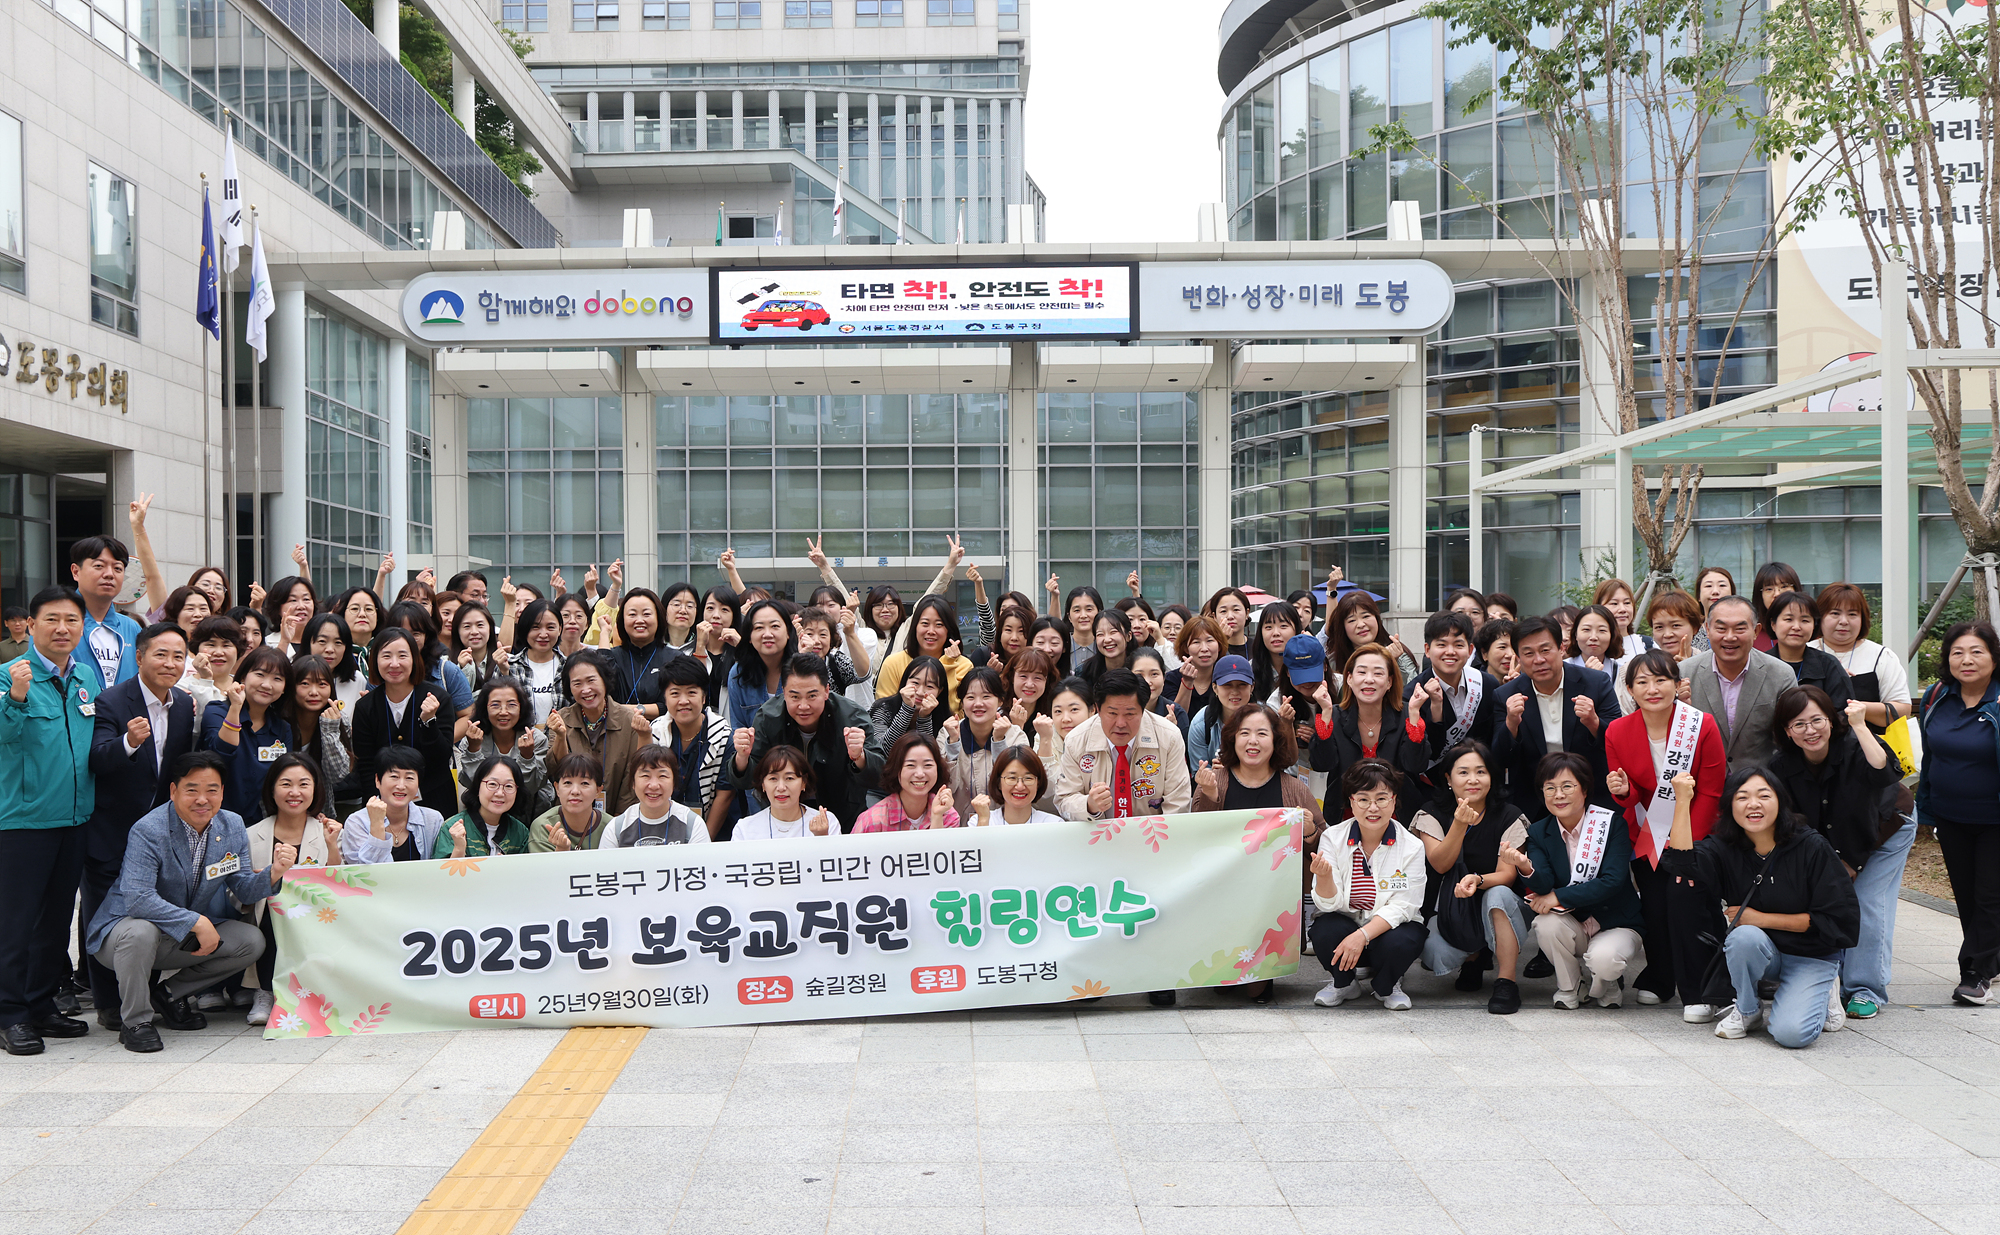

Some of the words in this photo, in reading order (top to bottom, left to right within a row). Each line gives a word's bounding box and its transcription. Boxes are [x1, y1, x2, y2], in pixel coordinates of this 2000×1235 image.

[841, 282, 895, 299] 타면
[968, 281, 1051, 298] 안전도
[1058, 278, 1104, 298] 착!
[1182, 283, 1343, 310] 변화·성장·미래
[1355, 280, 1410, 314] 도봉
[1848, 273, 1983, 300] 도구장
[478, 289, 576, 323] 함께해요!
[583, 289, 694, 320] dobong
[893, 304, 925, 312] 안전띠
[1039, 302, 1081, 310] 안전띠는
[1084, 301, 1105, 309] 필수
[16, 341, 128, 414] 도봉구의회
[1658, 750, 1682, 800] 강혜란
[1582, 819, 1596, 860] 서울시의원
[1593, 847, 1602, 864] 추석
[568, 871, 647, 899] 도봉구
[657, 855, 872, 894] 가정·국공립·민간
[880, 848, 983, 878] 어린이집
[401, 915, 610, 978] 2025년
[630, 893, 909, 966] 보육교직원
[928, 879, 1158, 948] 힐링연수
[477, 999, 521, 1018] 일시
[538, 984, 710, 1015] 25년9월30일(화)
[745, 979, 788, 1002] 장소
[805, 972, 887, 997] 숲길정원
[917, 969, 959, 990] 후원
[977, 961, 1058, 985] 도봉구청
